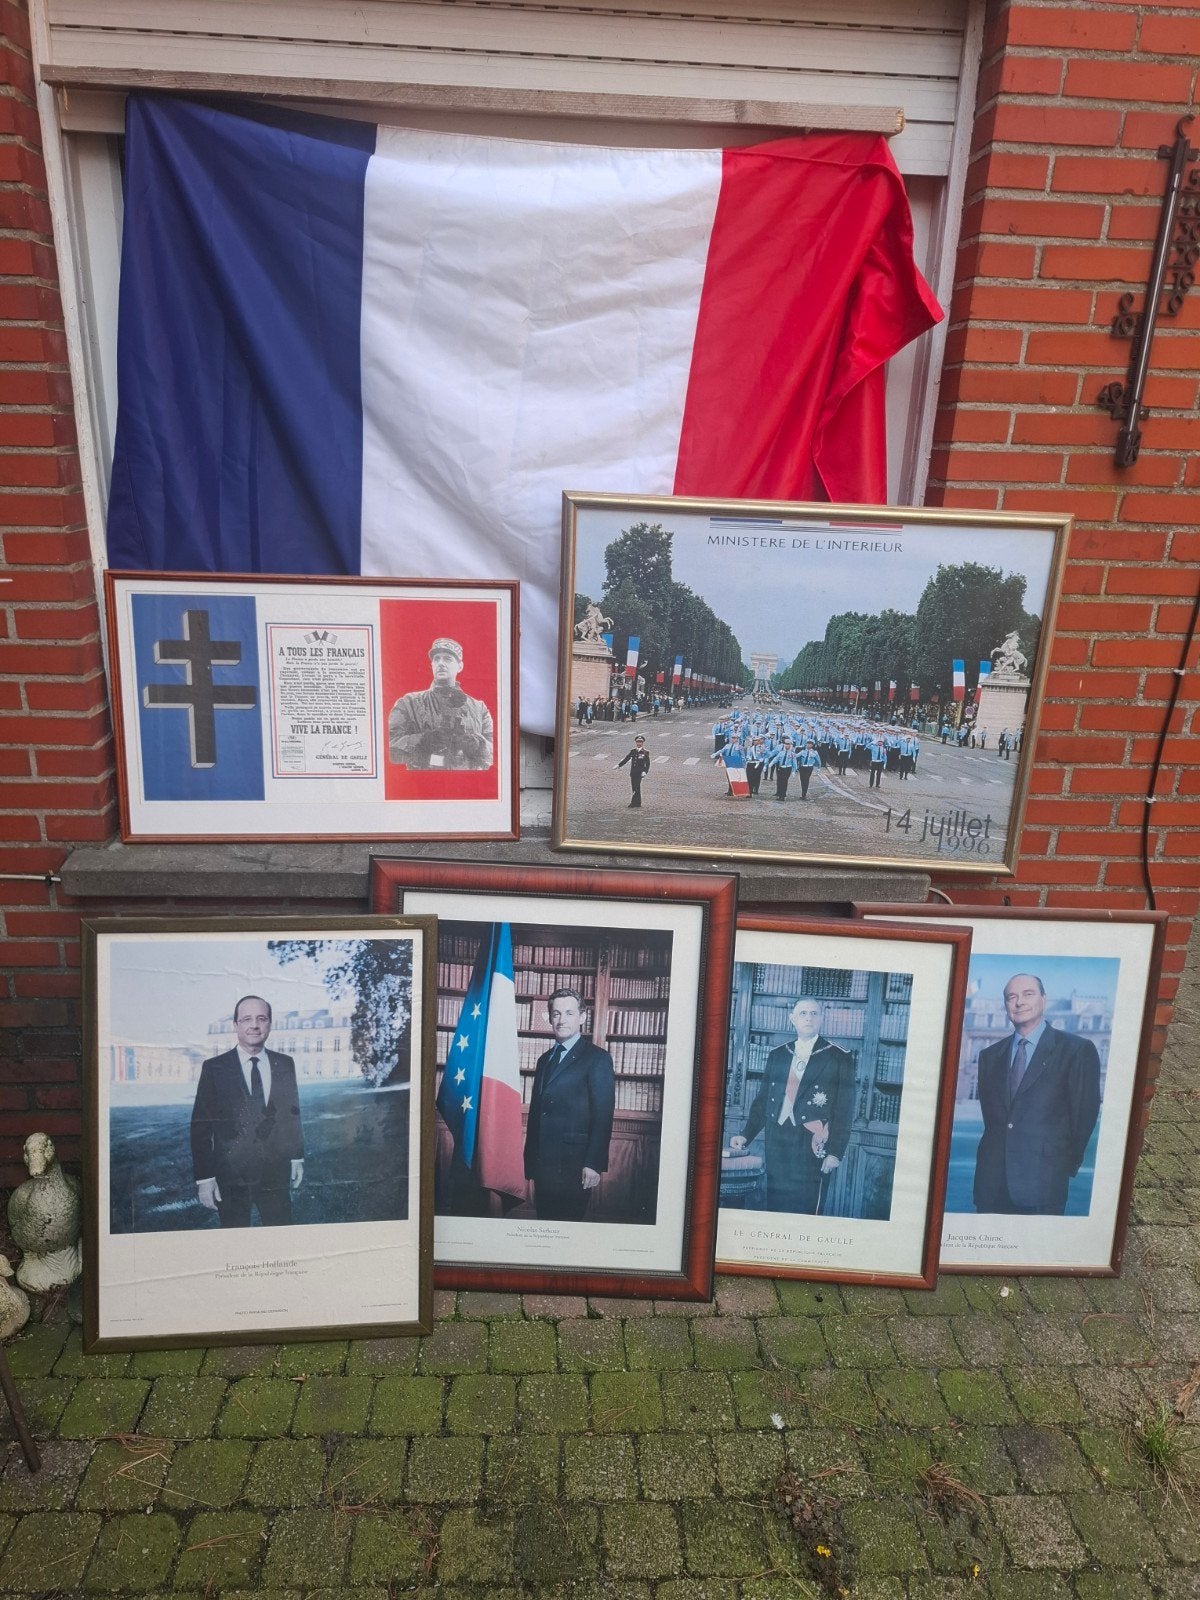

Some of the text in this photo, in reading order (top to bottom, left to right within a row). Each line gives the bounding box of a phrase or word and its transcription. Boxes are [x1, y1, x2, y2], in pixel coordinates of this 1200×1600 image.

[707, 535, 904, 553] MINISTERE DE L'INTERIEUR
[279, 646, 365, 658] A TOUS LES FRANÇAIS
[291, 725, 308, 734] VIVE
[311, 725, 320, 734] LA
[323, 725, 351, 734] FRANCE
[882, 807, 992, 842] 14 juillet
[734, 1229, 854, 1246] LE GÉNÉRAL DE GAULLE
[946, 1234, 977, 1242] Jacques
